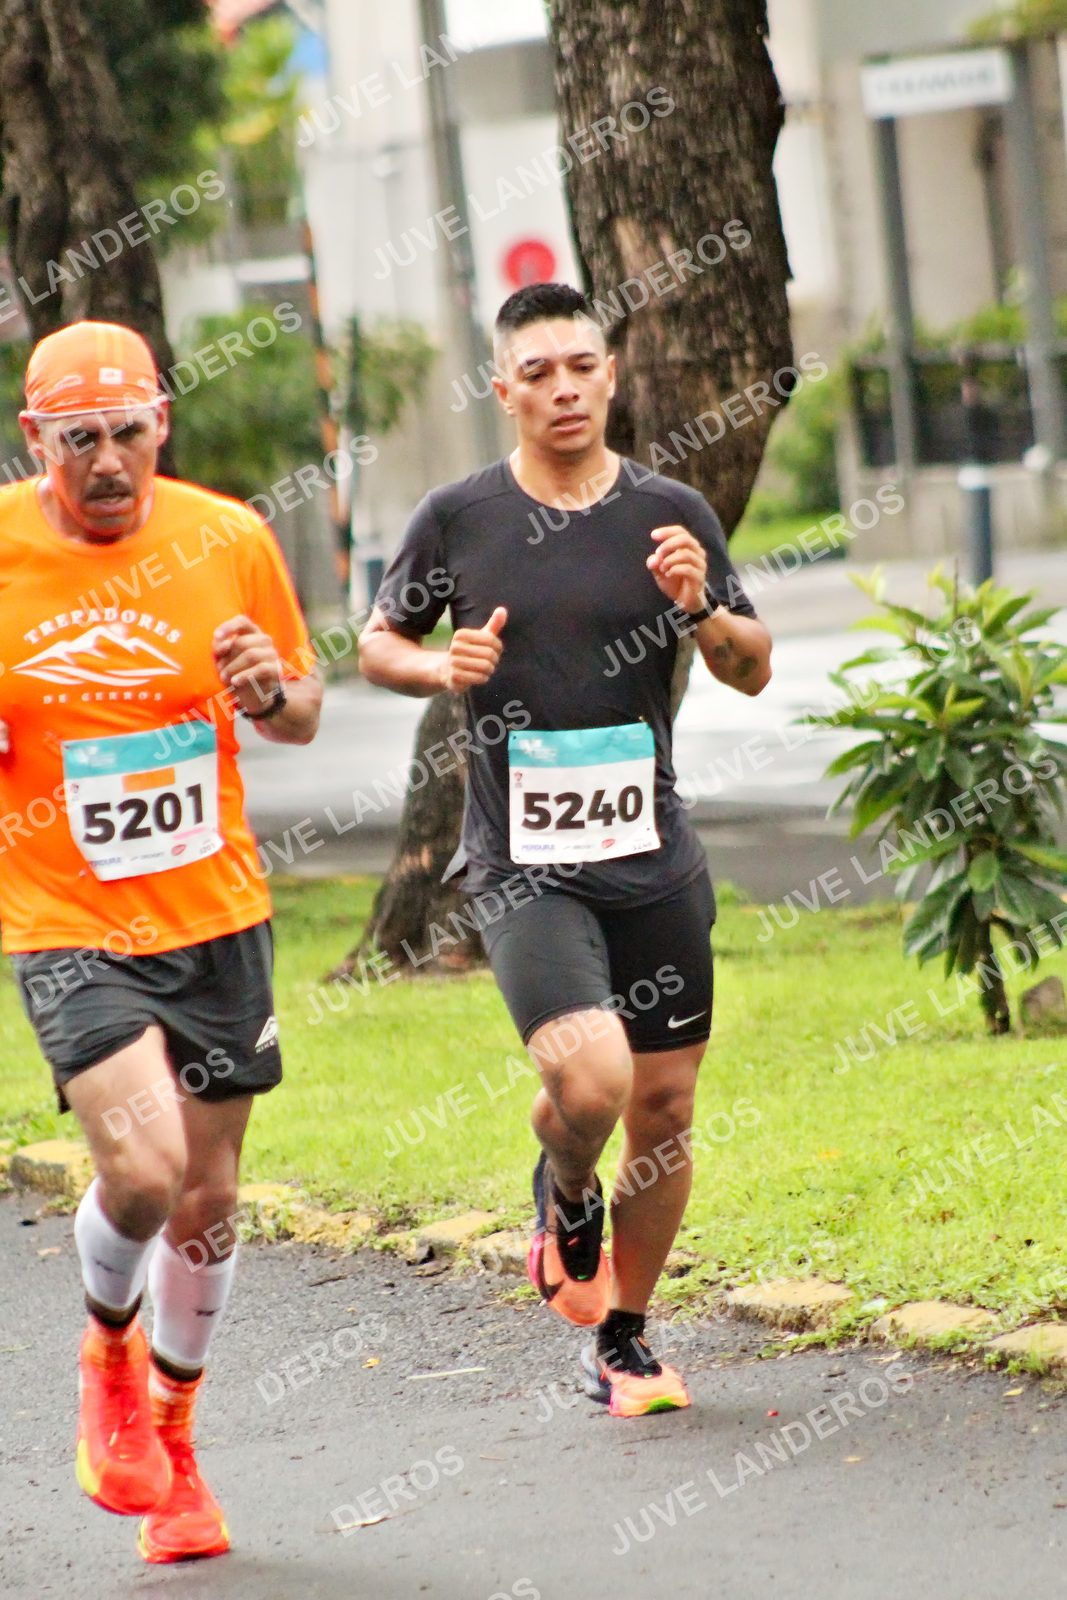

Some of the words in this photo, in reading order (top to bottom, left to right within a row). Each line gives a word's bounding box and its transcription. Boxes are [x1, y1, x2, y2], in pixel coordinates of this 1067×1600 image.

[24, 607, 181, 645] TREPADORES
[43, 694, 68, 704] DE
[82, 783, 204, 845] 5201
[521, 785, 644, 831] 5240
